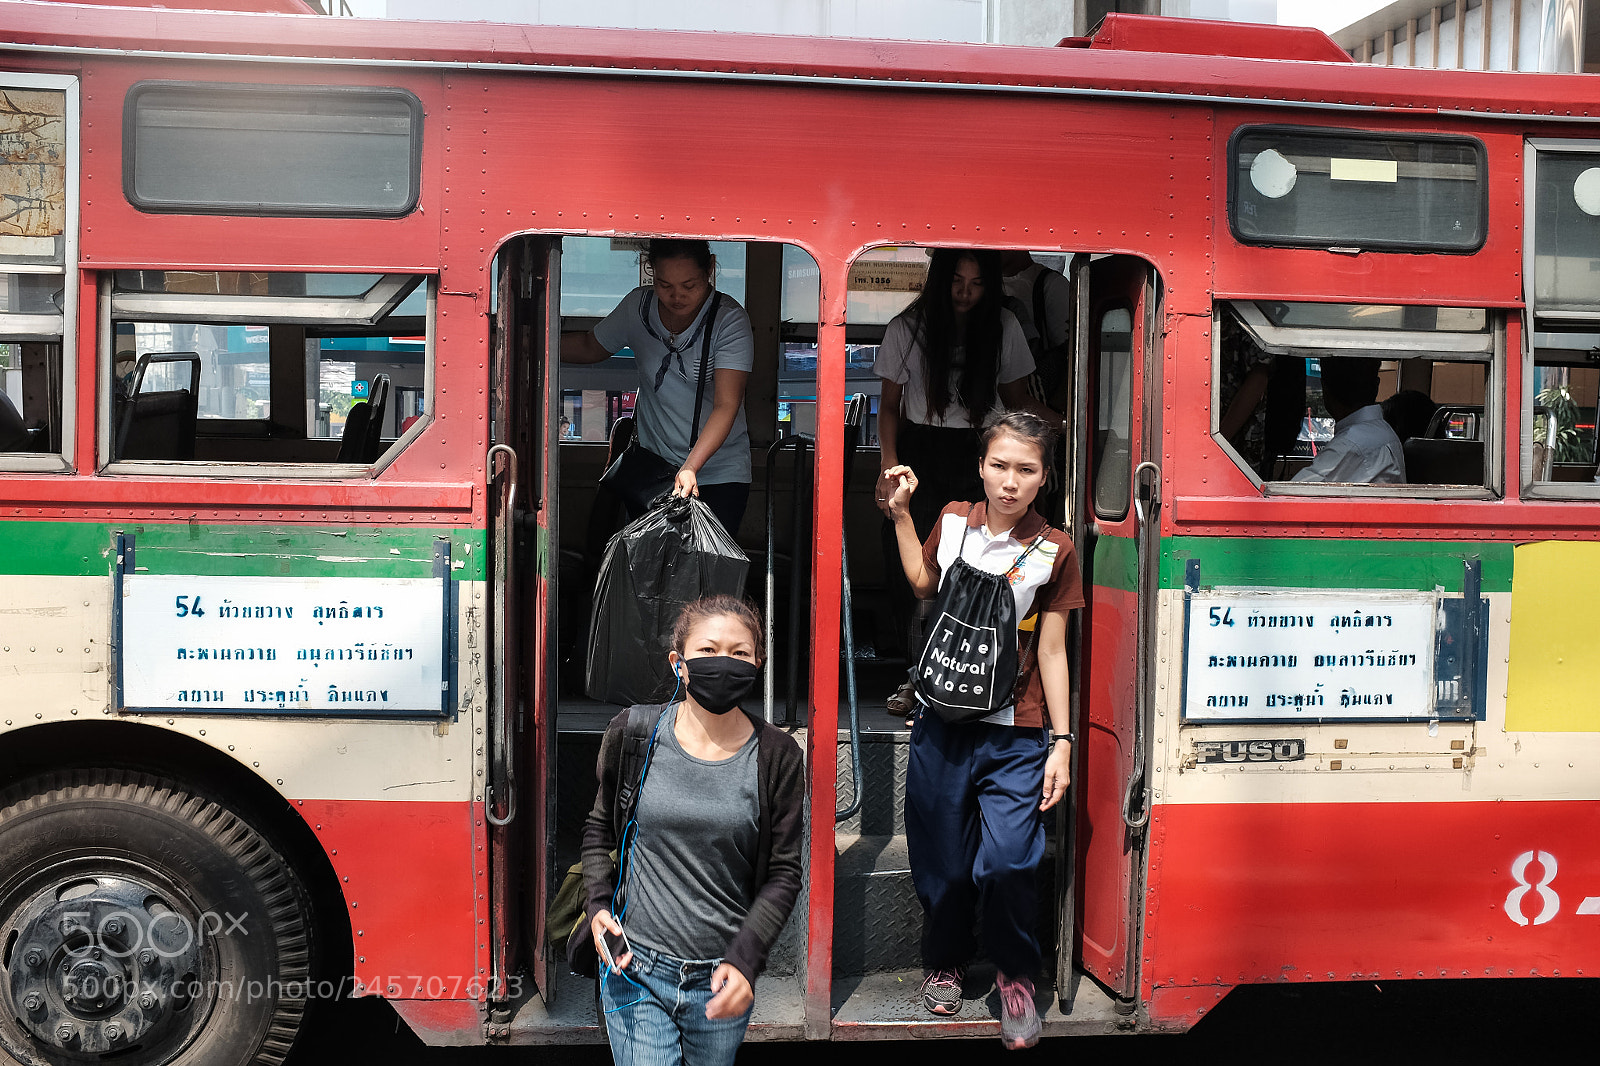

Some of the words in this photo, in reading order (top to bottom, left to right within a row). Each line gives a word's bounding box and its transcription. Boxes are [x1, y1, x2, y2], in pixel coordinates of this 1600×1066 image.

[176, 595, 205, 618] 54
[1209, 606, 1235, 628] 54
[942, 628, 989, 655] The
[930, 647, 986, 676] Natural
[923, 666, 984, 695] Place
[1197, 741, 1301, 763] FUSO
